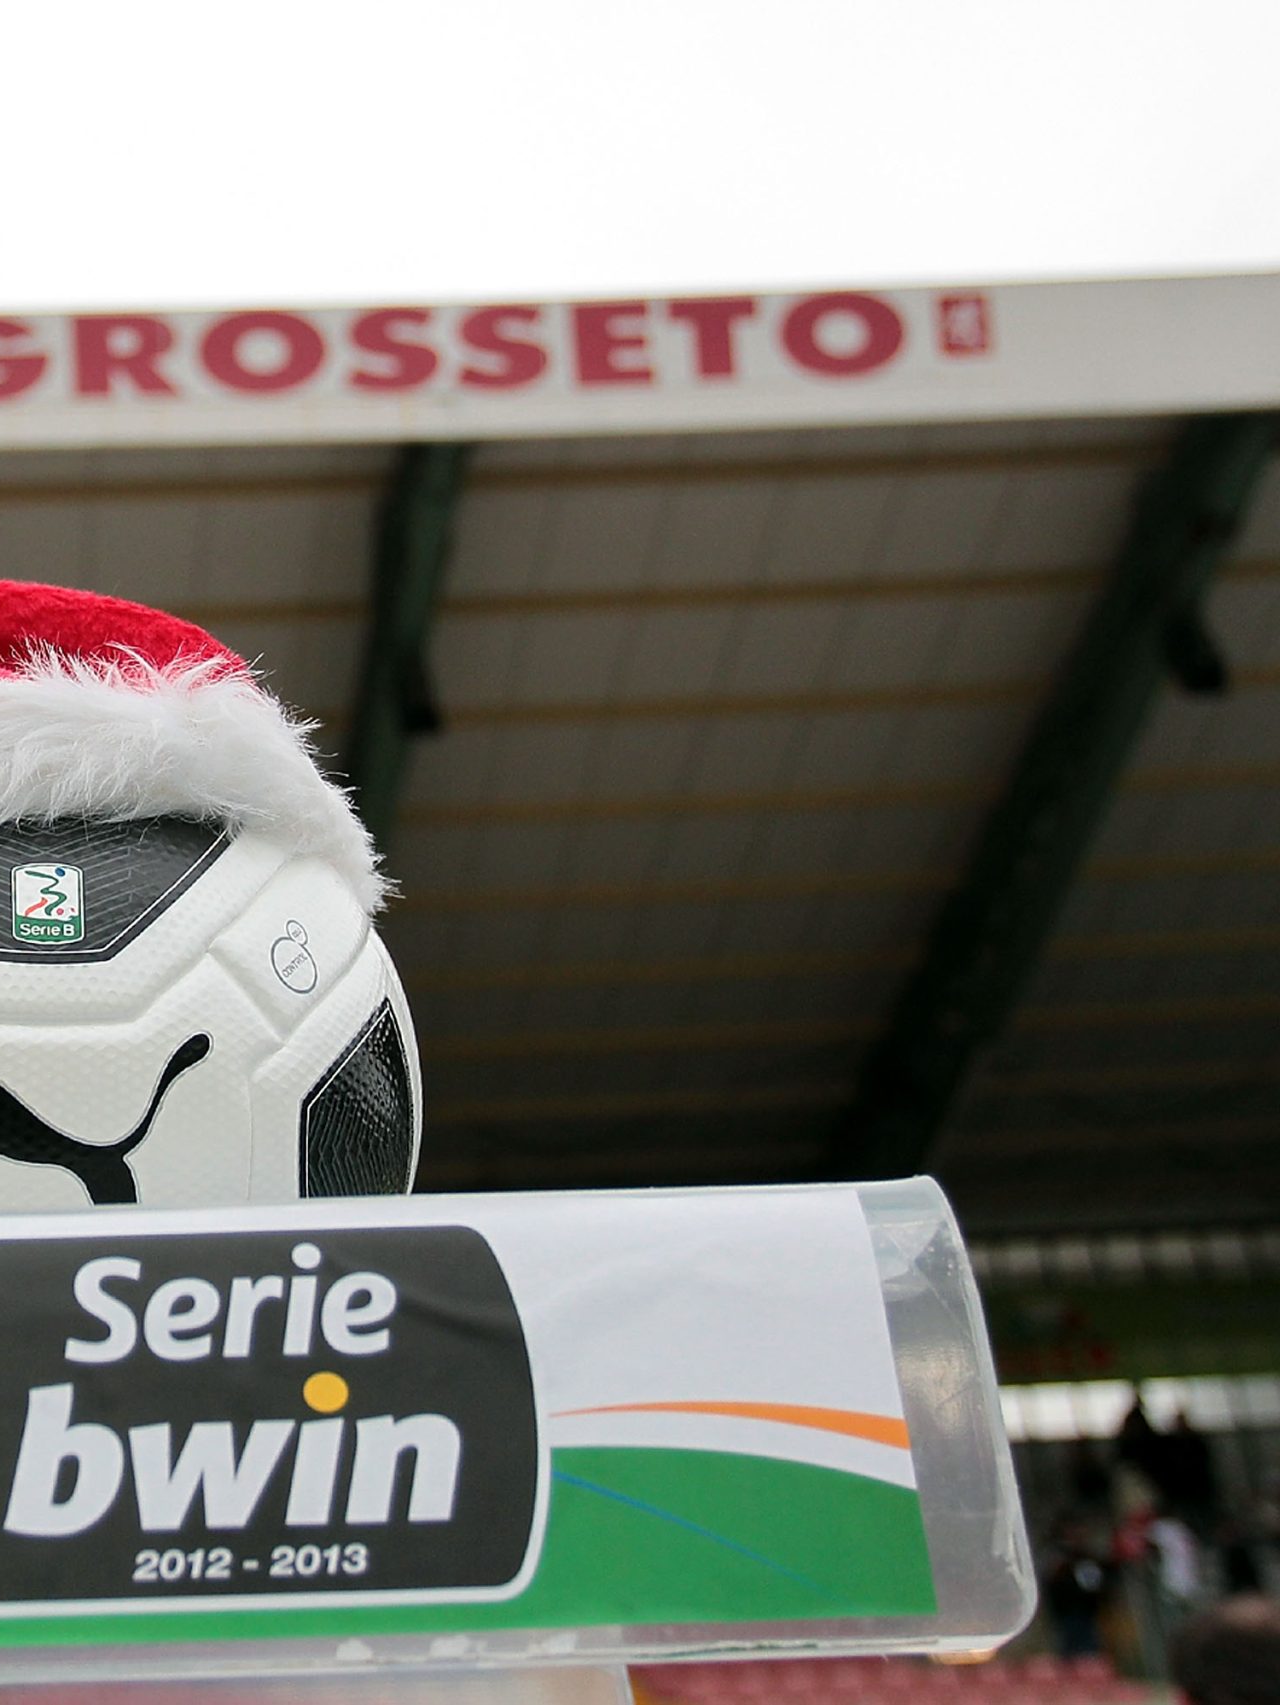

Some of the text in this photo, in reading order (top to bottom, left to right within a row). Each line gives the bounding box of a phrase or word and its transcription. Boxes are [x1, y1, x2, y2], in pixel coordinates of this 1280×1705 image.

[20, 923, 75, 937] Serie B
[64, 1242, 398, 1364] Serie
[3, 1370, 462, 1537] bwin
[132, 1548, 233, 1583] 2012
[269, 1542, 370, 1577] 2013
